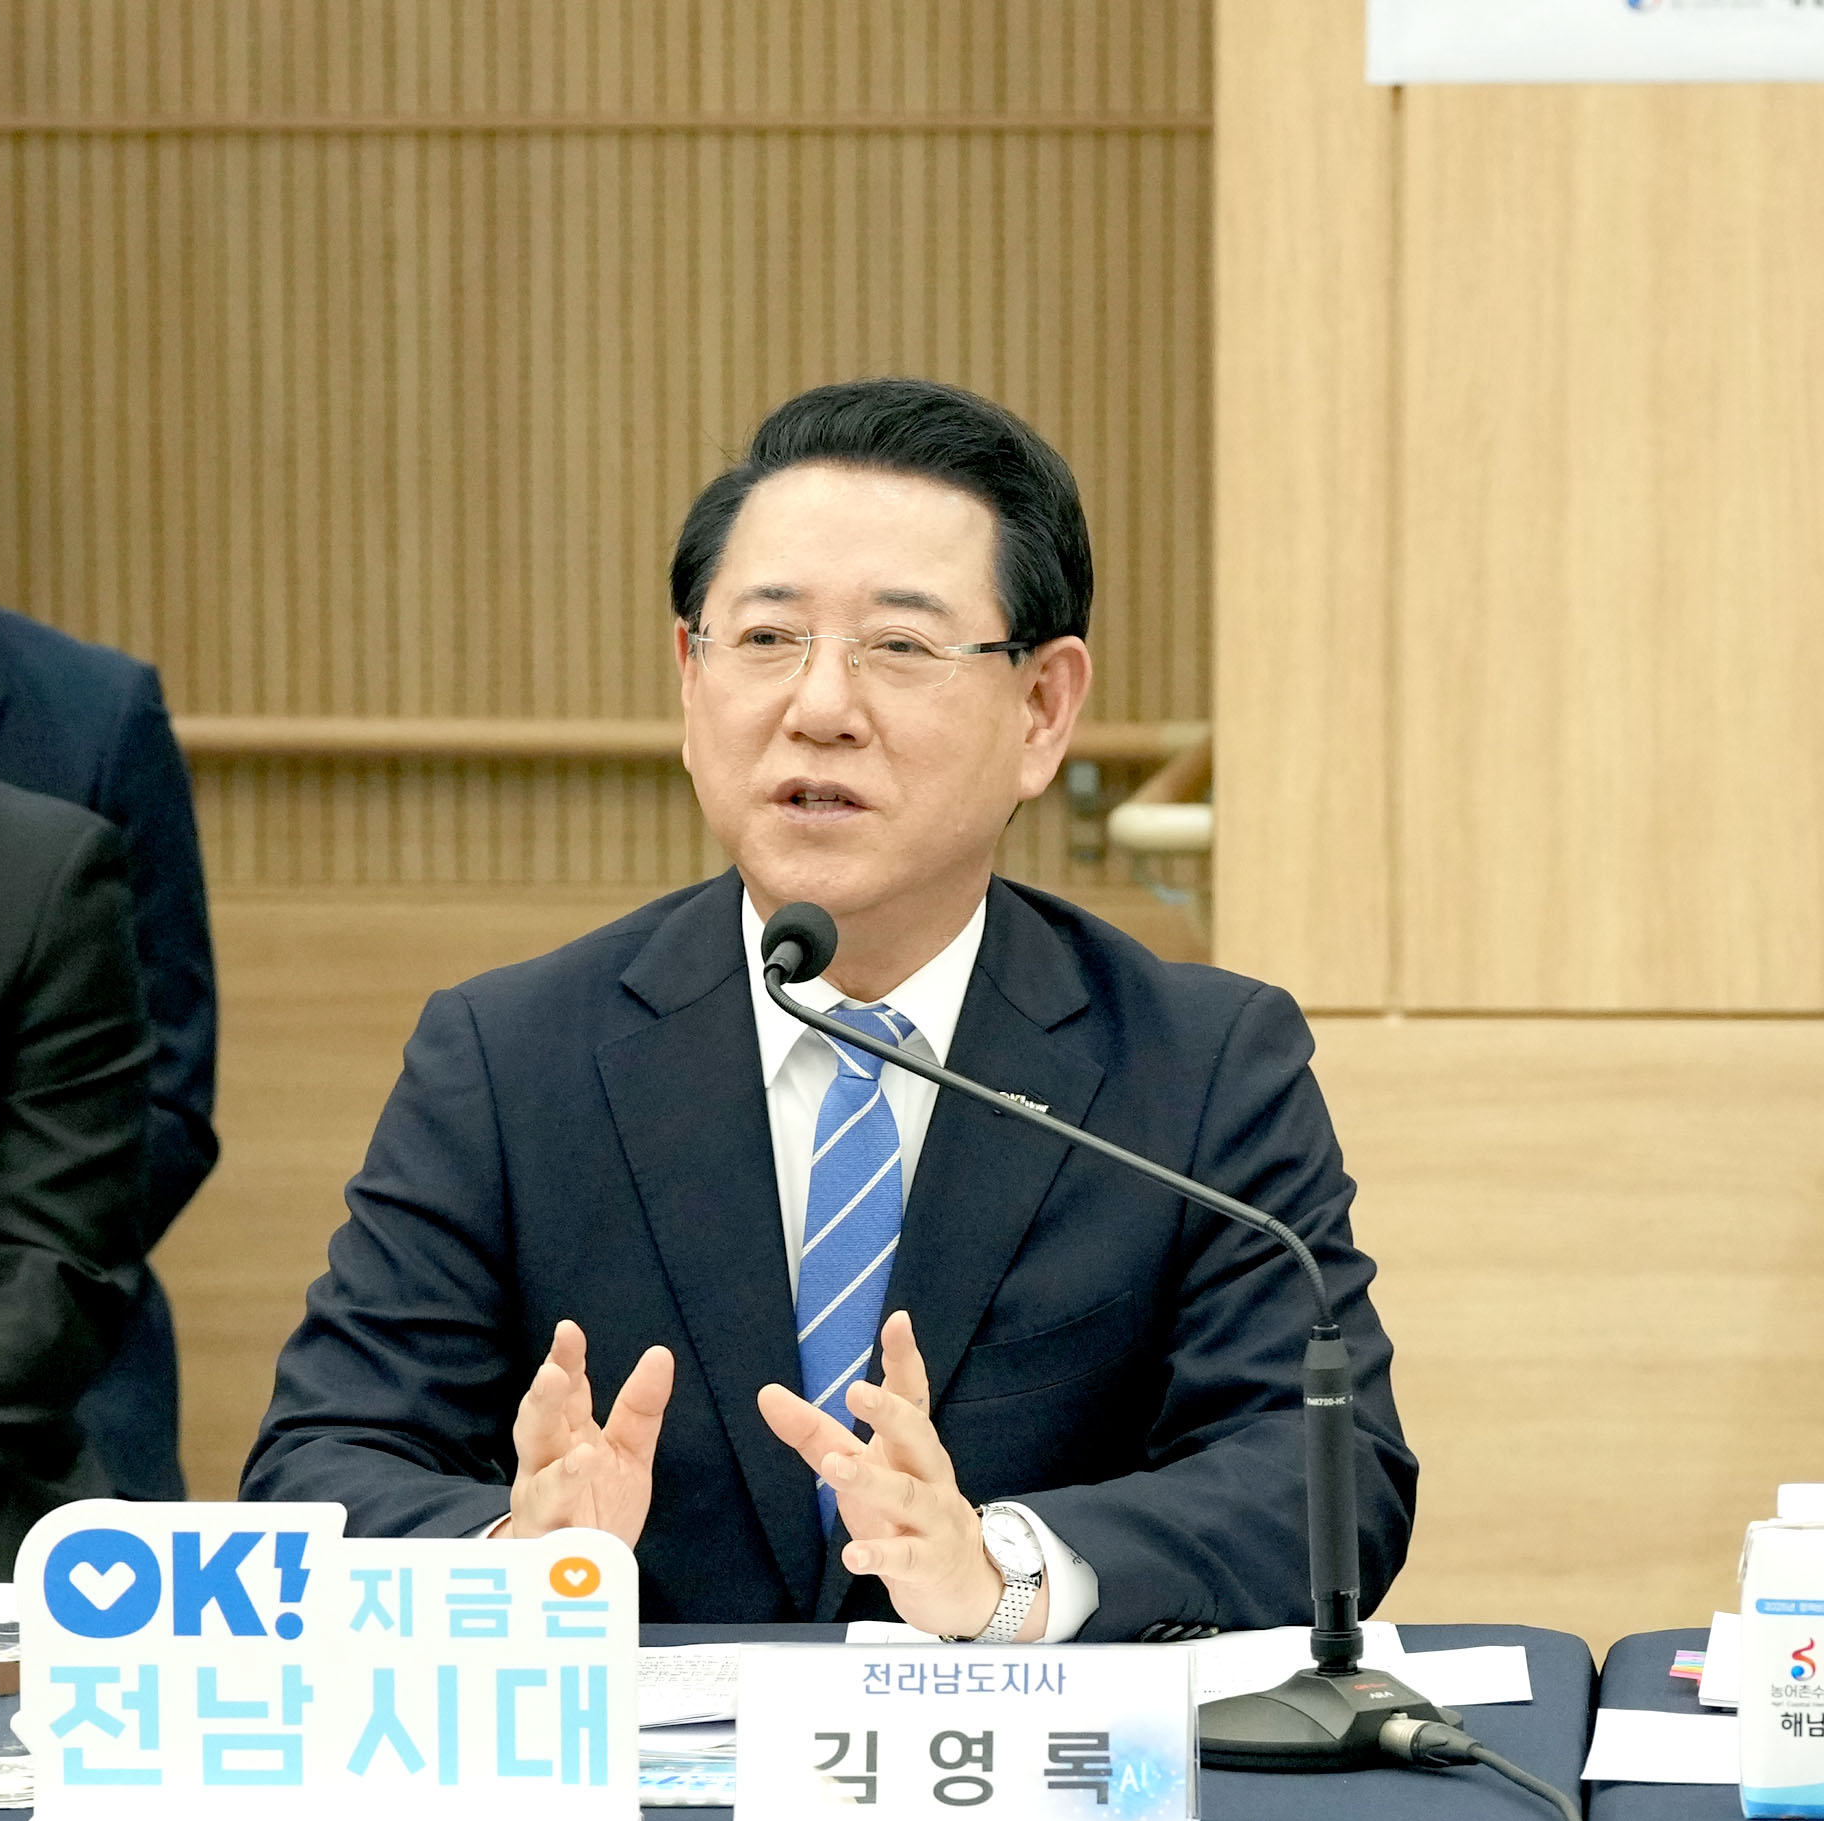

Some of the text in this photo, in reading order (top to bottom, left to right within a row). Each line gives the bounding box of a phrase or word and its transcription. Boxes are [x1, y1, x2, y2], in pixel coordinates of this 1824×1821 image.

[43, 1528, 609, 1640] OK! 지금은
[861, 1662, 1067, 1696] 전라남도지사
[1120, 1763, 1149, 1795] AI
